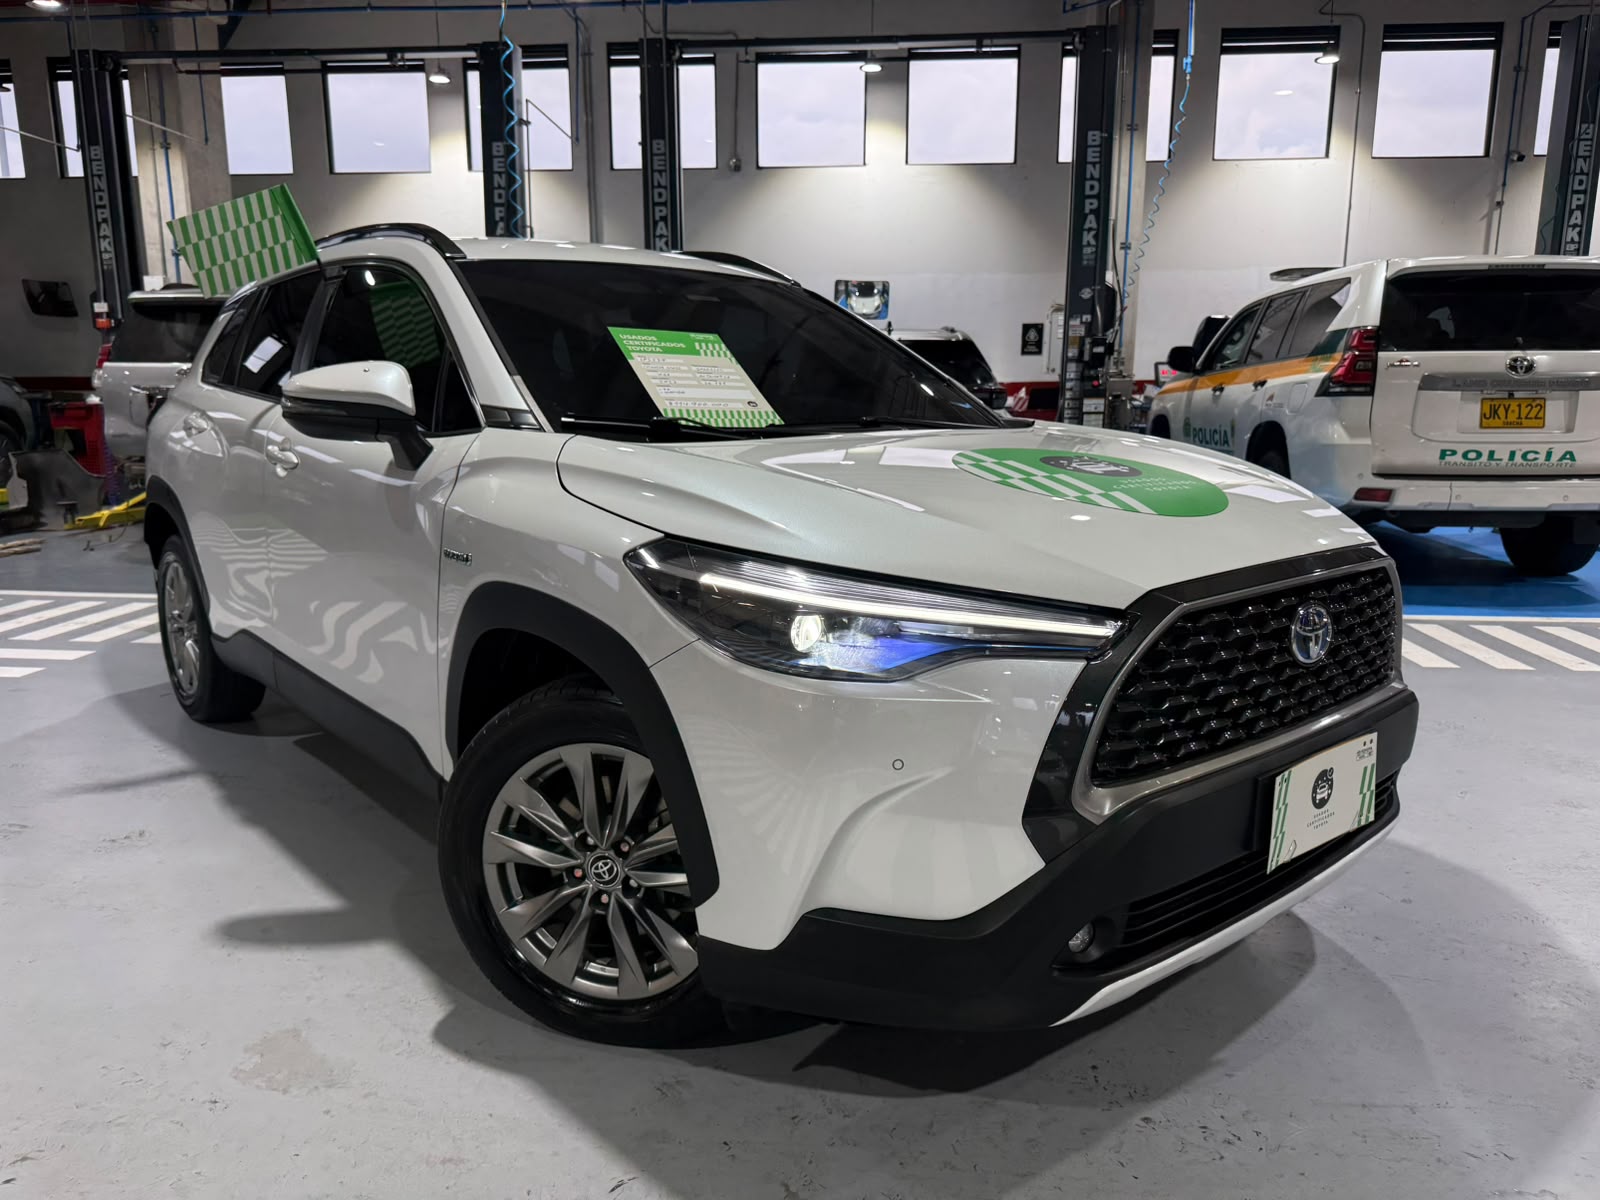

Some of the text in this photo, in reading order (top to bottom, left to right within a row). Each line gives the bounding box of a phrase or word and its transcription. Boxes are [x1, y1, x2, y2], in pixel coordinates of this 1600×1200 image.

[90, 145, 113, 252] BENDPAK
[492, 141, 506, 236] BENDPA
[652, 139, 668, 252] BENDPAK
[1082, 130, 1101, 245] BENDPAK
[1565, 123, 1594, 242] BENDPAK
[623, 340, 686, 348] CERTIFICADOS
[1192, 425, 1230, 448] POLICÍA
[1439, 447, 1577, 462] POLICÍA
